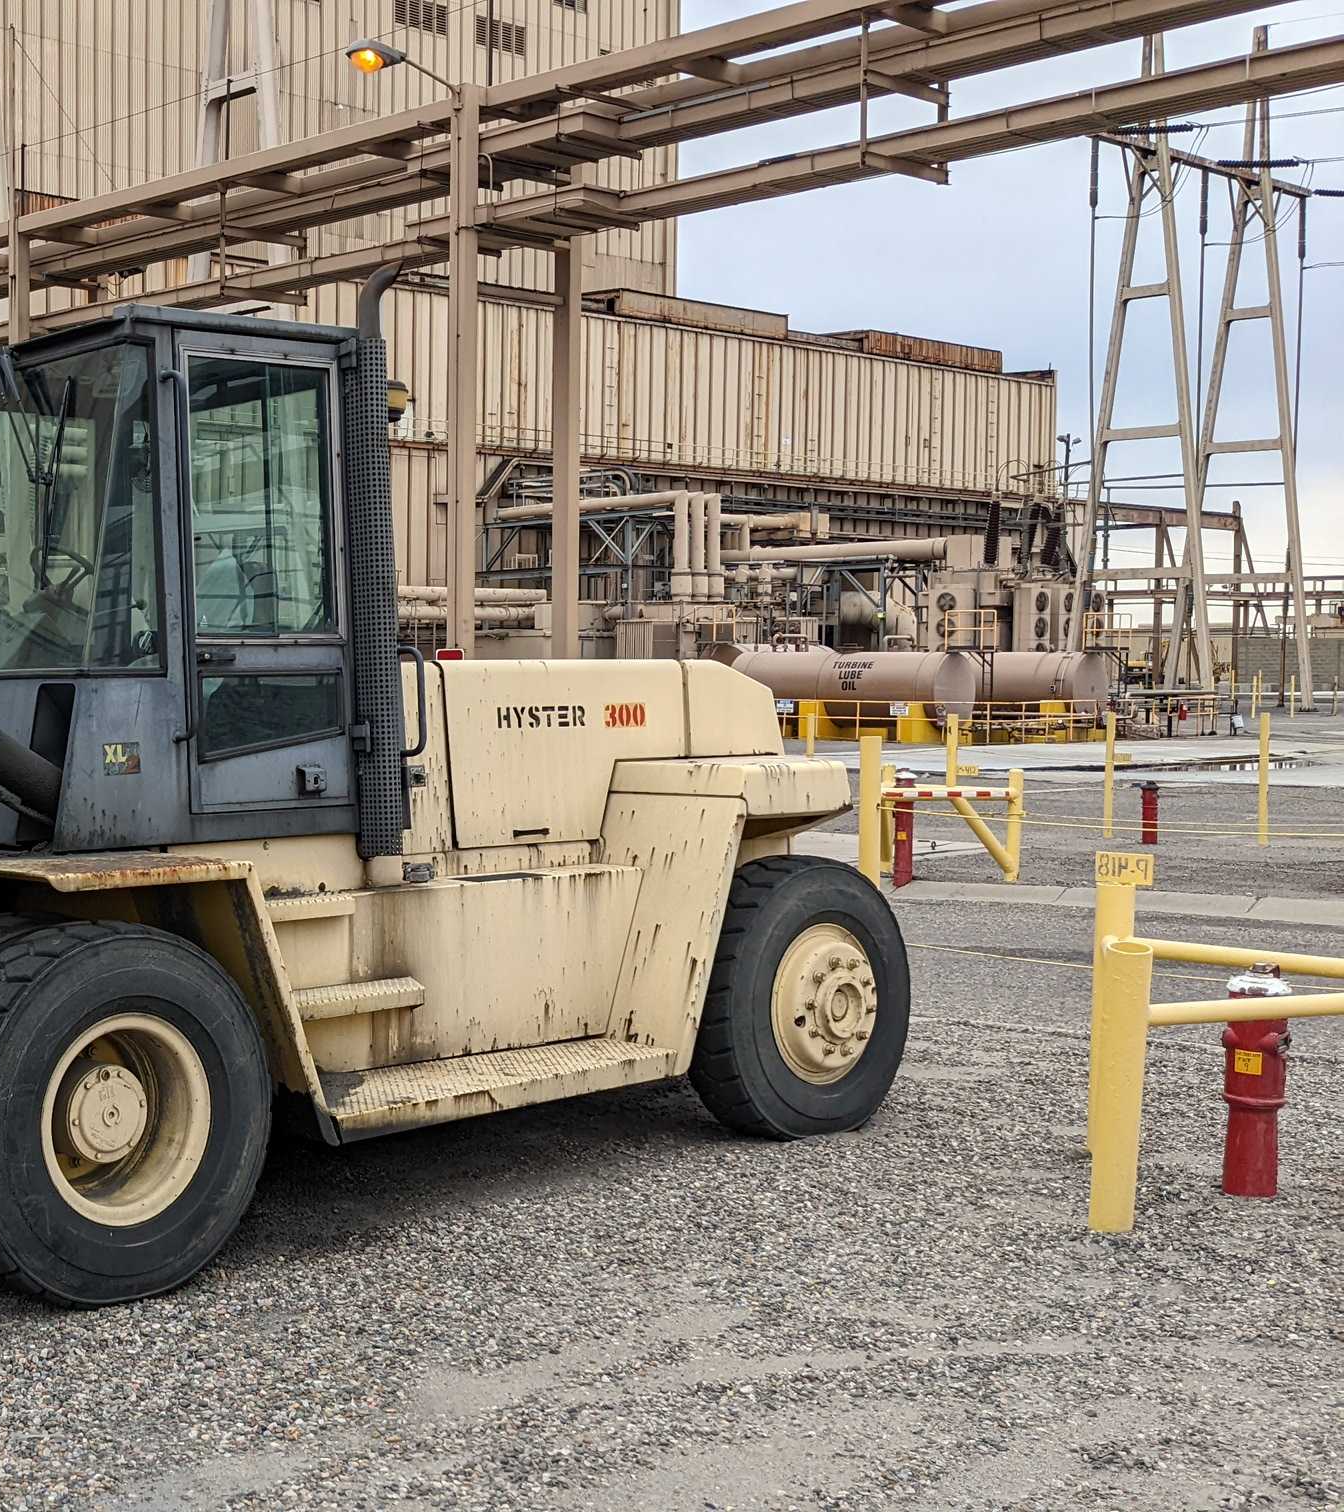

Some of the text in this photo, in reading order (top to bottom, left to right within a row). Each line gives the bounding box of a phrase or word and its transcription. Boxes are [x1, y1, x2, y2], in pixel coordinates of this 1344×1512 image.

[832, 661, 875, 669] TURBINE
[838, 670, 864, 680] LUBE
[841, 680, 857, 691] OIL
[496, 703, 646, 729] HYSTER 300
